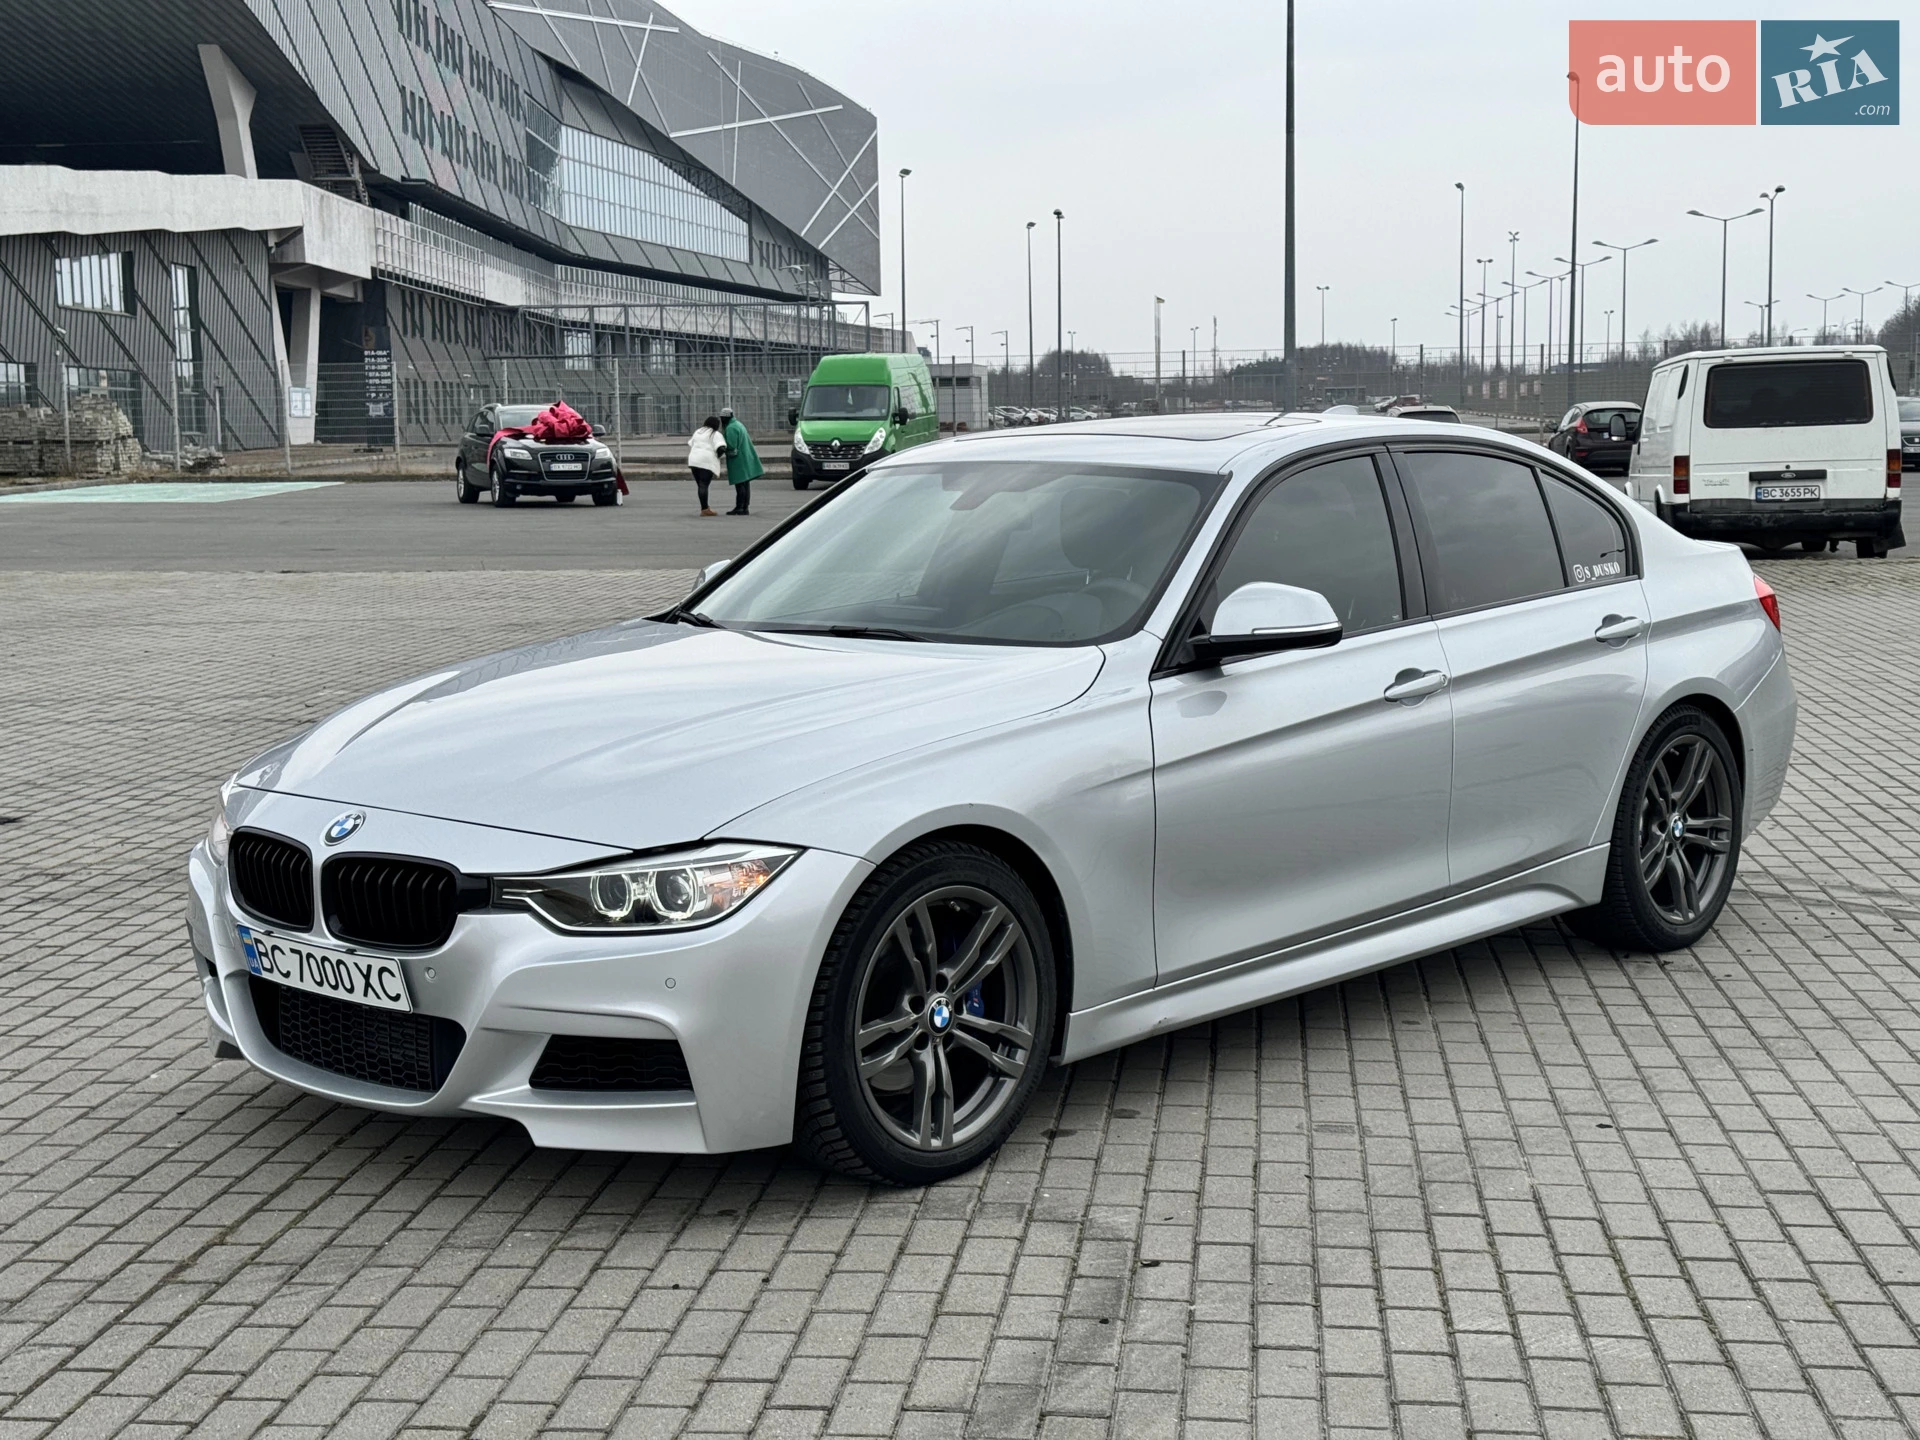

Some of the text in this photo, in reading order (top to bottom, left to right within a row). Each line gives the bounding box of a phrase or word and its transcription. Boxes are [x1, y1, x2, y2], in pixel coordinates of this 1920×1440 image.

[1762, 489, 1778, 498] BC
[1780, 488, 1802, 498] 3655
[1803, 487, 1818, 498] PK
[1584, 561, 1620, 580] S_DUSKO
[253, 937, 402, 1003] BC 7000 XC
